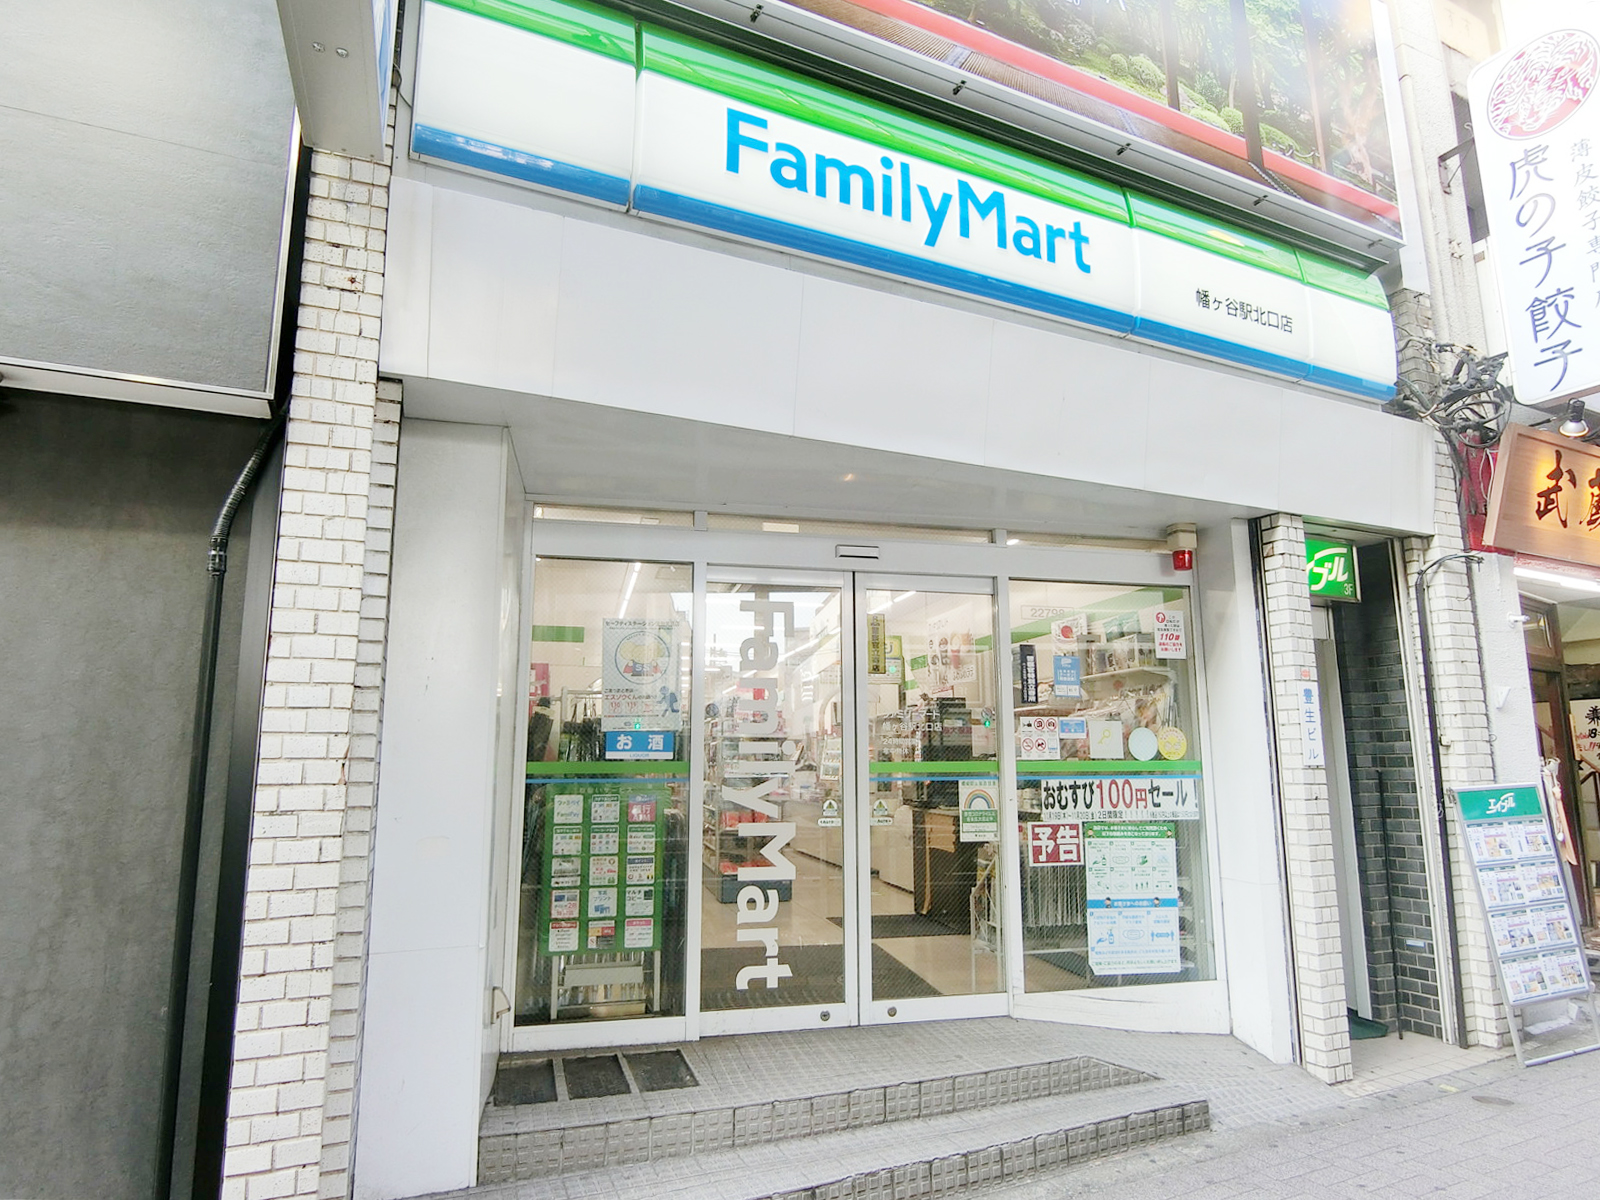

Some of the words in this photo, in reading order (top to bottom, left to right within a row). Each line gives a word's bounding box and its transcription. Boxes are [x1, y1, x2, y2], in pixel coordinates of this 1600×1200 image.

[726, 107, 1091, 274] FamilyMart
[1509, 144, 1584, 393] 虎の子餃子
[1196, 287, 1293, 334] 幡ヶ谷駅北口店
[1344, 583, 1354, 596] 3F
[616, 734, 664, 750] お酒
[722, 599, 797, 991] FamilyMart
[1033, 825, 1080, 862] 予告
